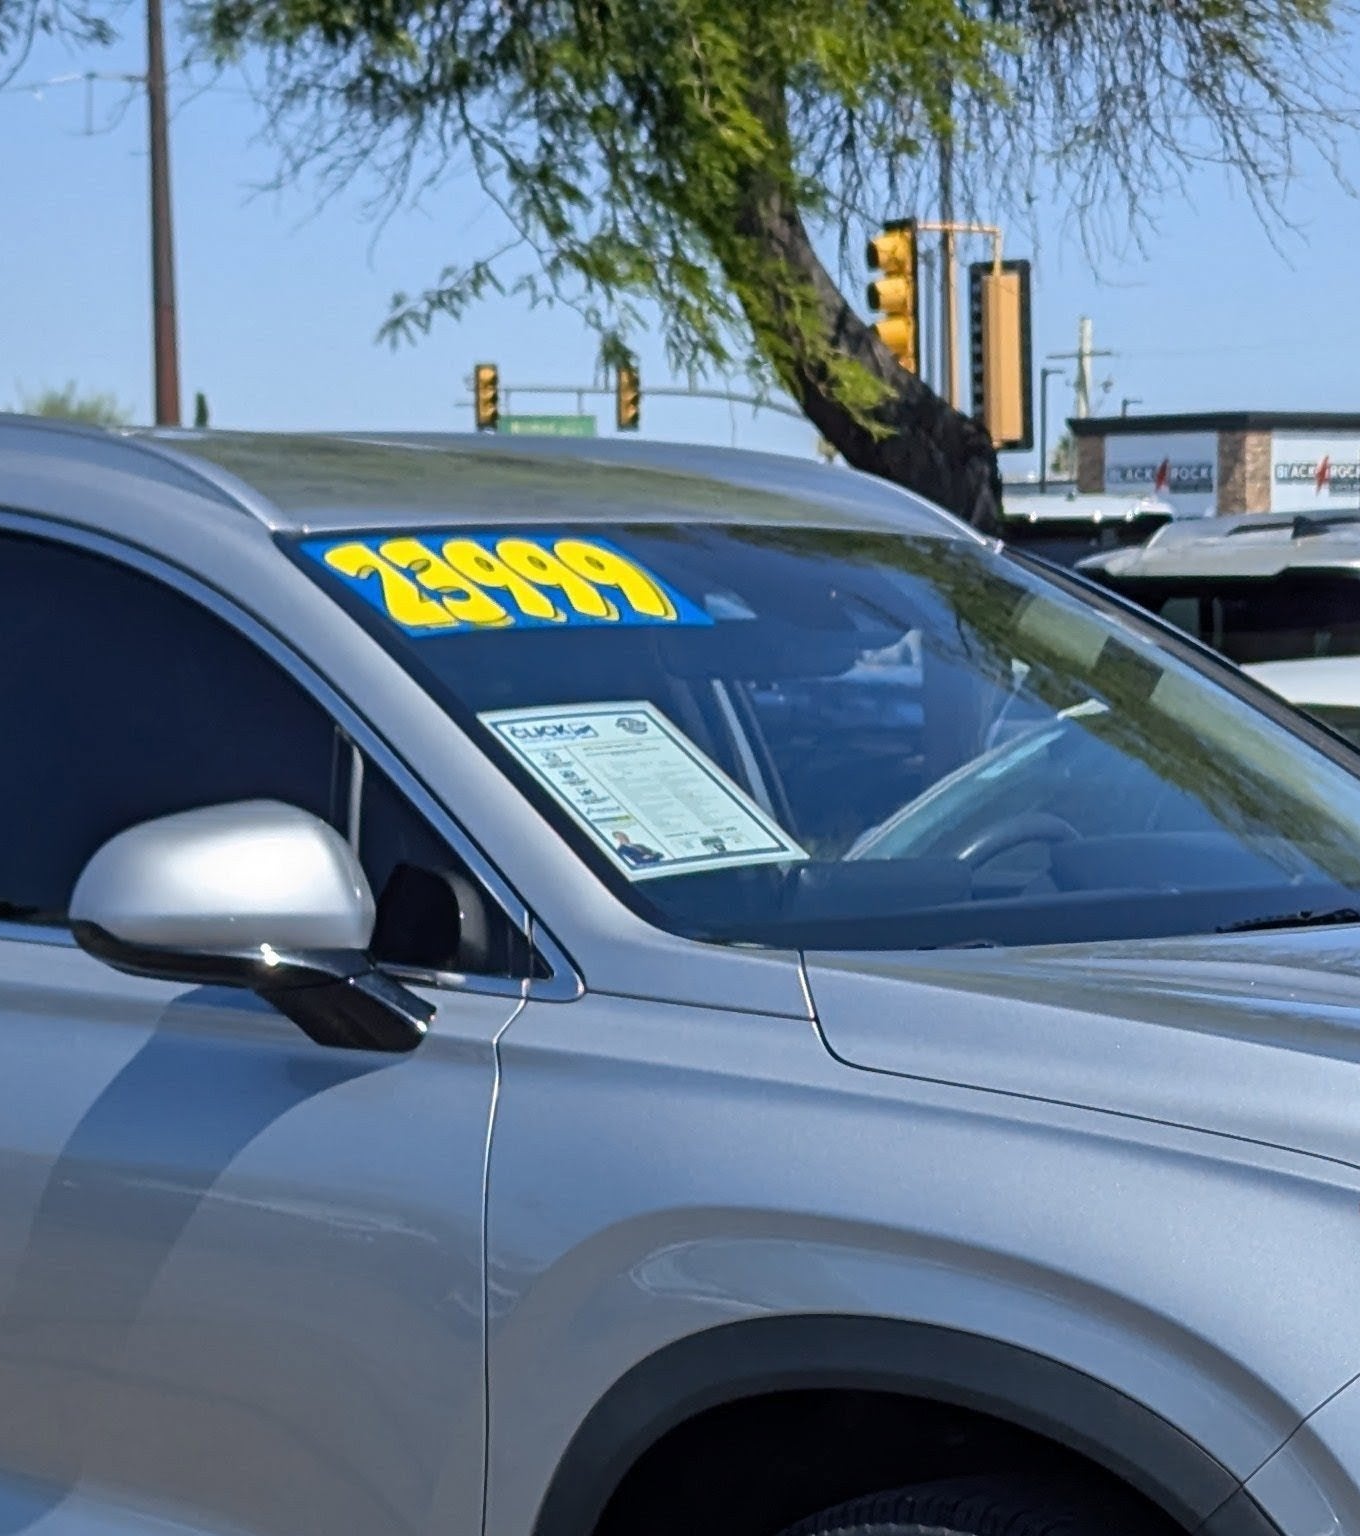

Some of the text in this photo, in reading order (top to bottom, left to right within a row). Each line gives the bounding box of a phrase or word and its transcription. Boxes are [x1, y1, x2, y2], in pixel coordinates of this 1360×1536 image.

[1170, 467, 1210, 480] ROCK
[1276, 465, 1315, 478] BLACK
[324, 537, 677, 628] 23999
